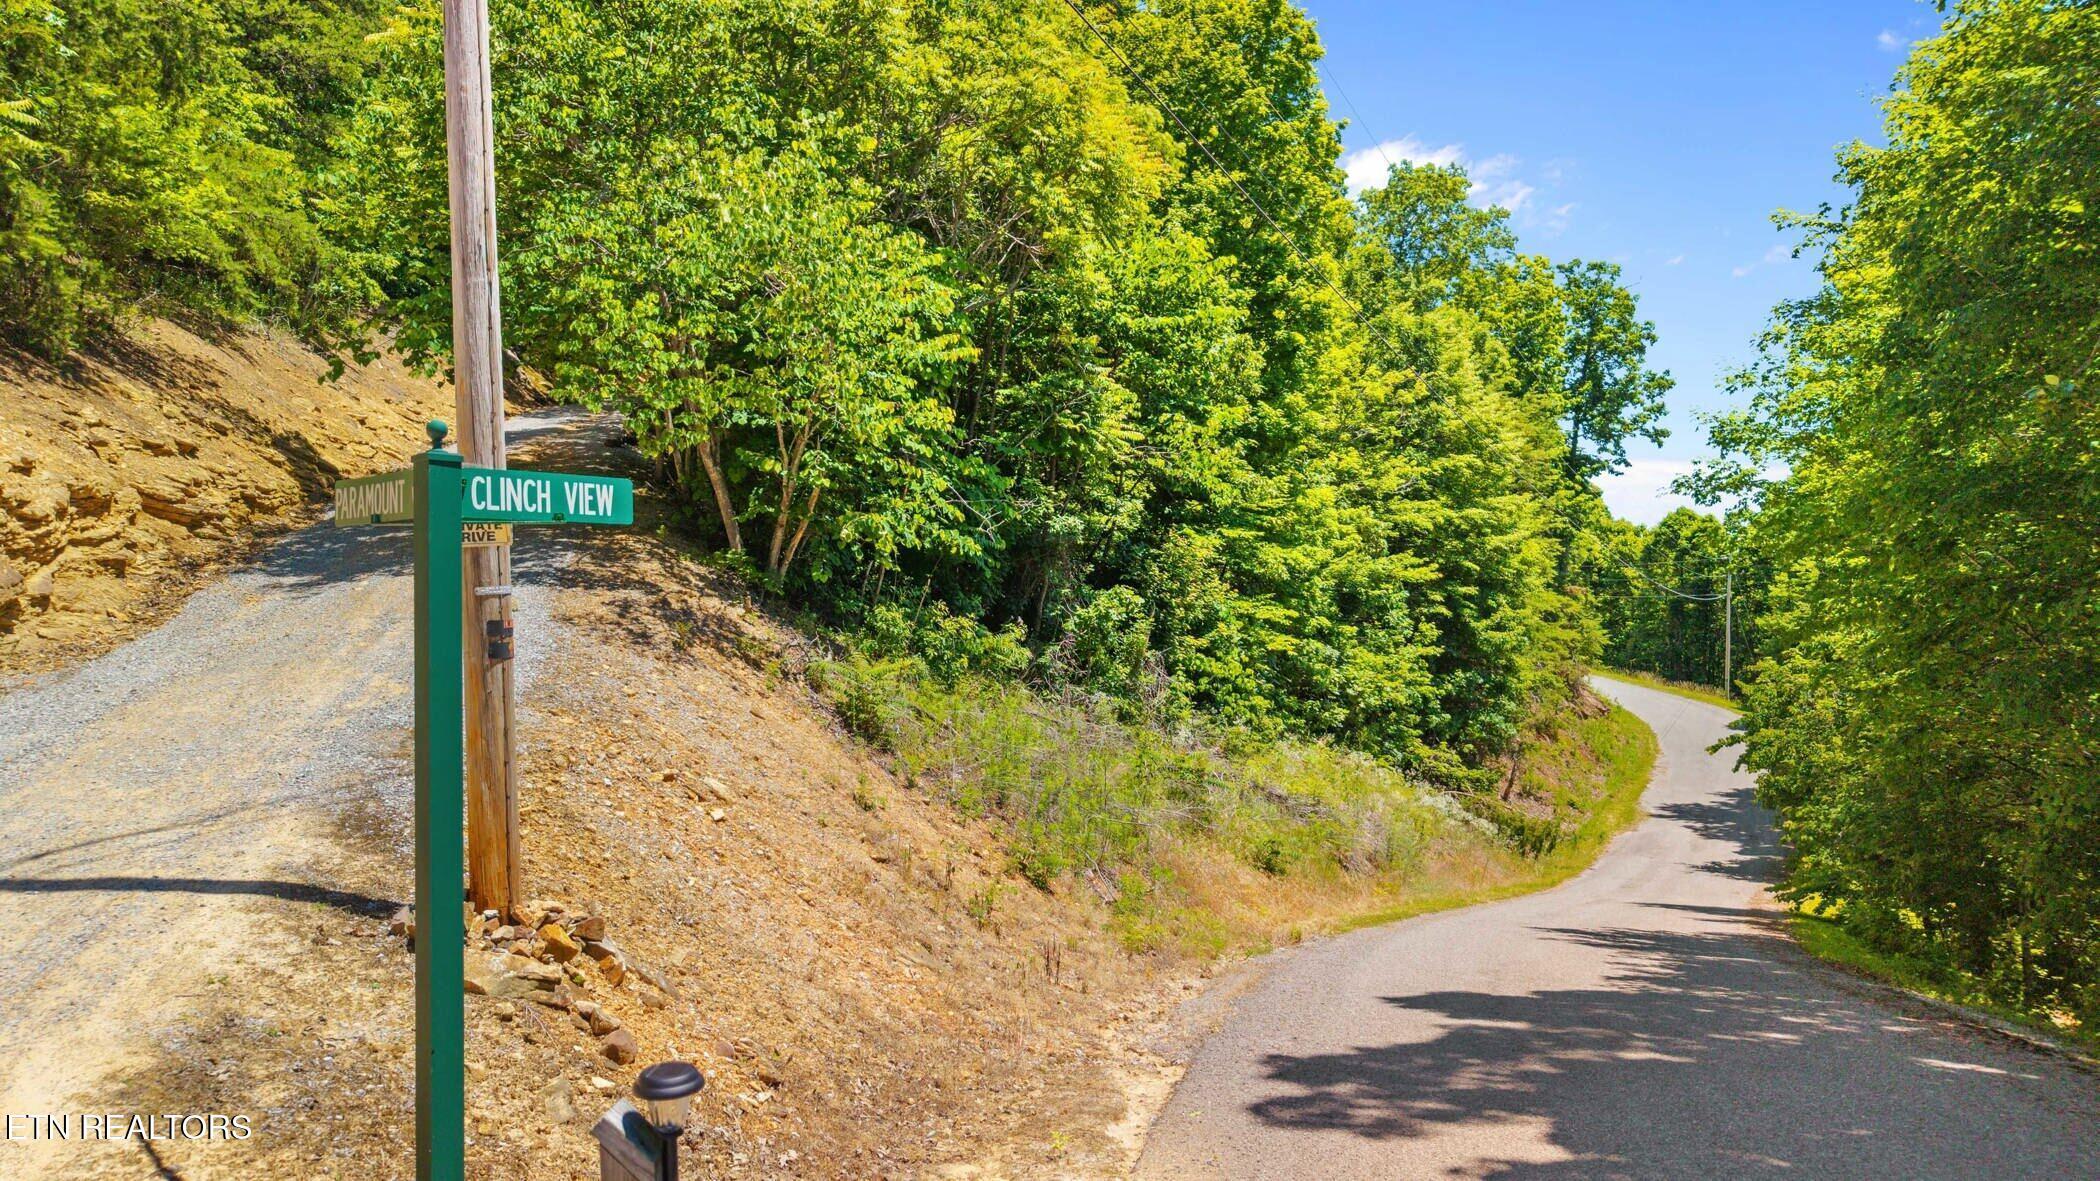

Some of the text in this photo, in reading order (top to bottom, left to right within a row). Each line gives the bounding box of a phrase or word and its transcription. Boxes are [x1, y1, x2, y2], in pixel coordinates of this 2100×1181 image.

[335, 479, 405, 521] PARAMOUNT
[470, 475, 614, 517] CLINCH VIEW
[462, 522, 503, 531] IVATE
[462, 531, 496, 543] RIVE
